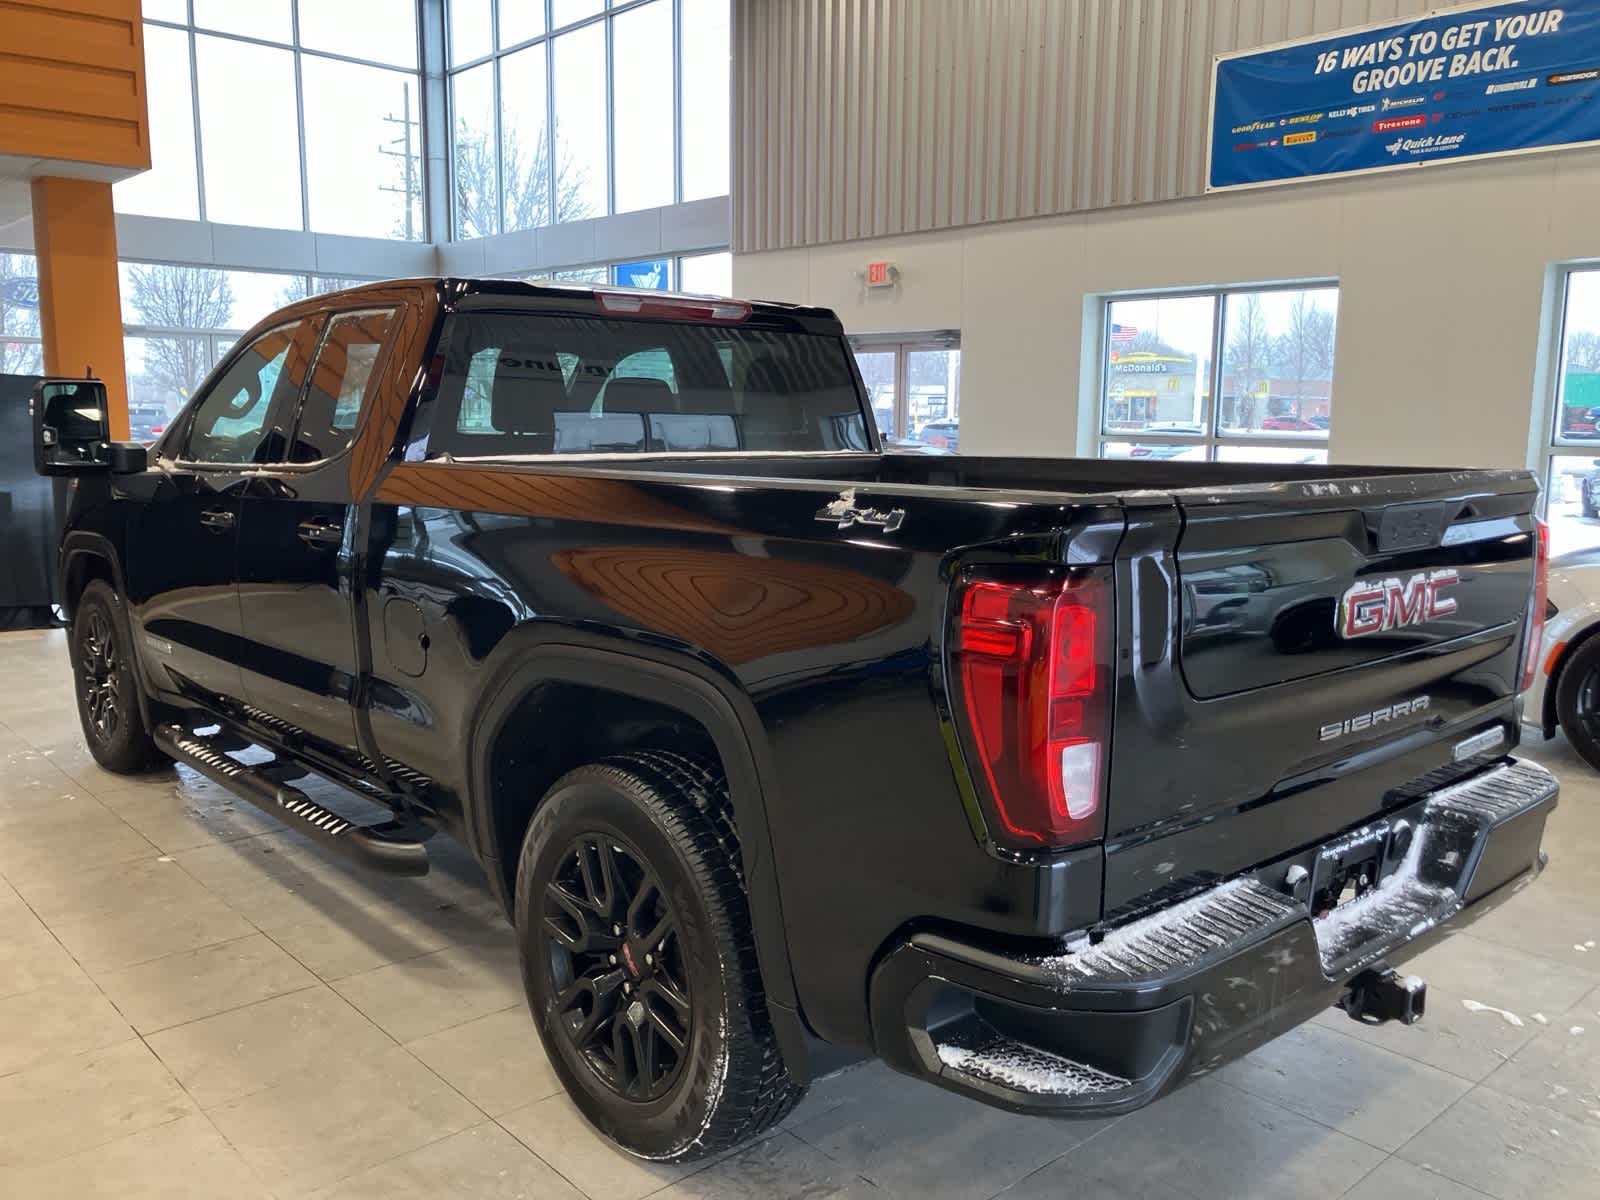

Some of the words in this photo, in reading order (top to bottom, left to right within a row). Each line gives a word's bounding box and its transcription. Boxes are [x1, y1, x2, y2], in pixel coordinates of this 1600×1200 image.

[1314, 50, 1339, 75] 16
[1341, 37, 1404, 69] WAYS
[1409, 31, 1437, 57] TO
[1441, 21, 1489, 51] GET
[1494, 9, 1564, 42] YOUR
[1352, 56, 1447, 94] GROOVE
[1448, 45, 1519, 78] BACK.
[1378, 118, 1422, 131] Firestone
[1402, 136, 1435, 150] Quick
[1435, 134, 1464, 145] Lane
[1116, 363, 1167, 374] McDonald's
[1343, 569, 1460, 640] GMC
[1319, 695, 1430, 741] SIERRA
